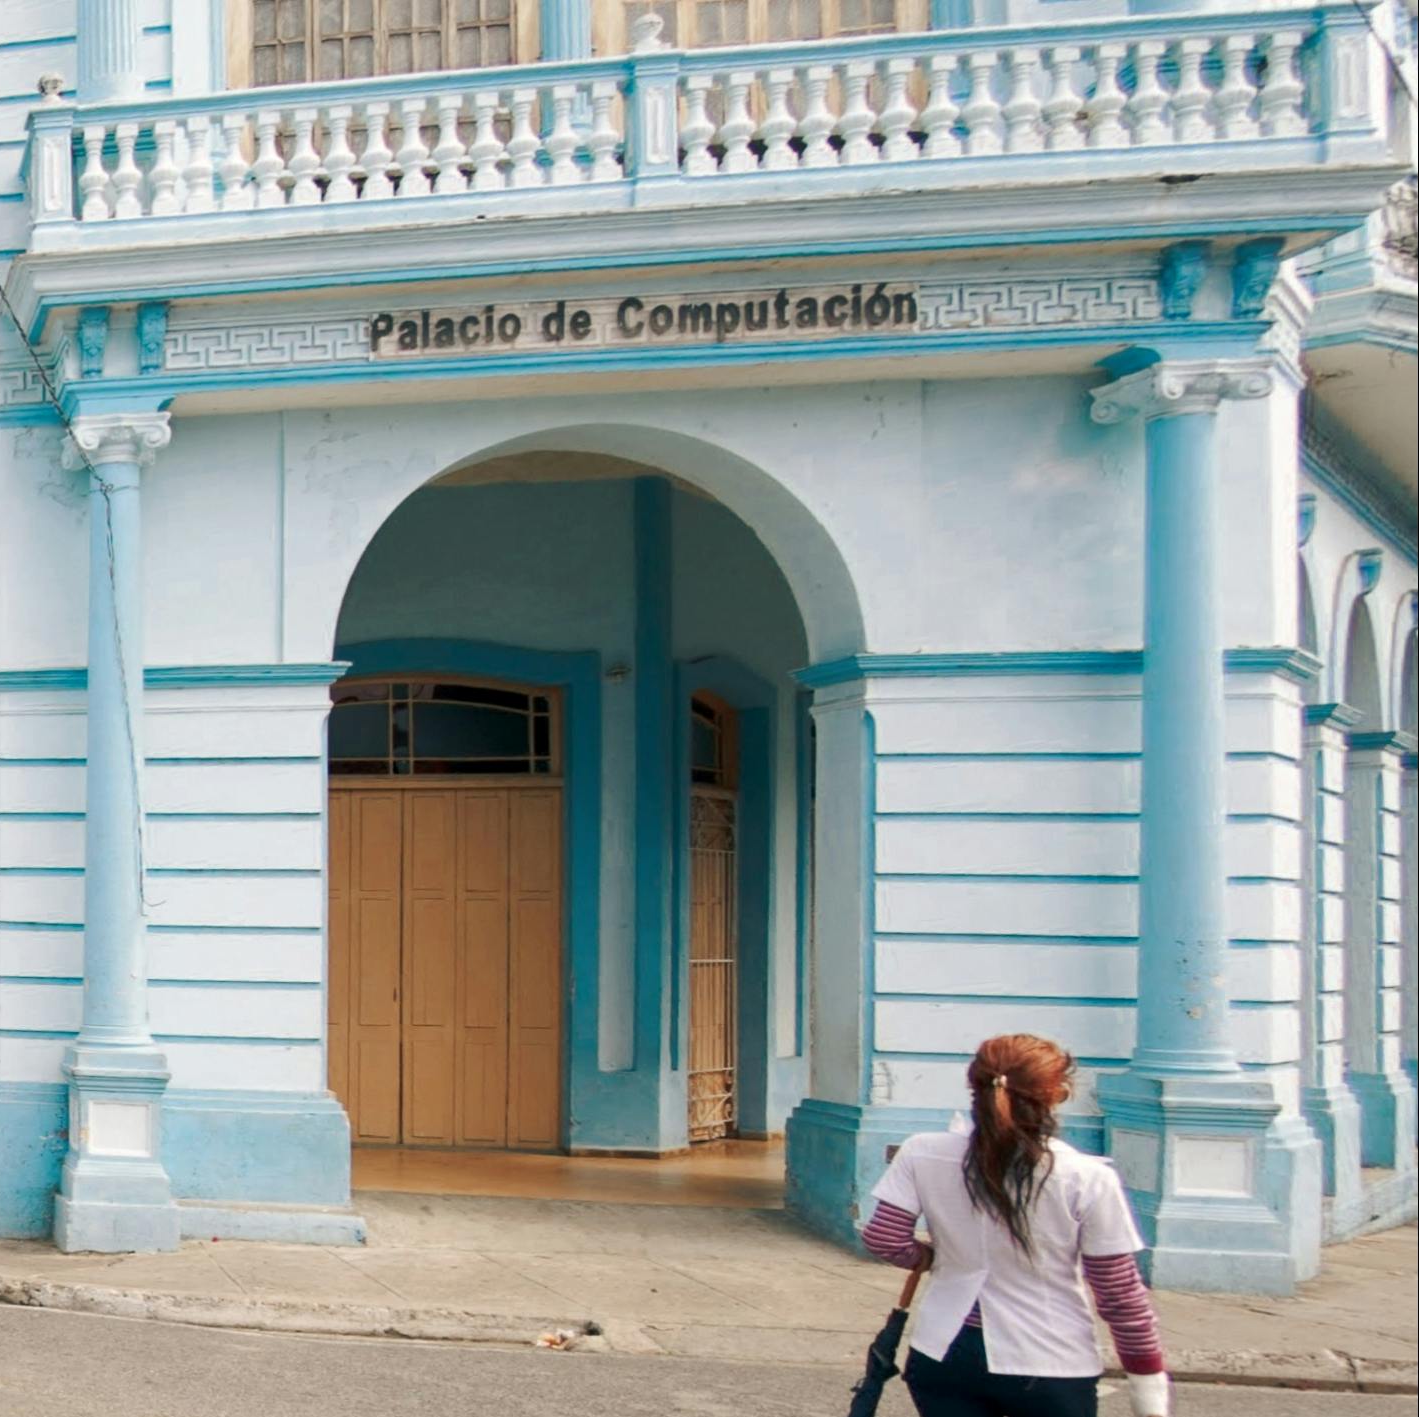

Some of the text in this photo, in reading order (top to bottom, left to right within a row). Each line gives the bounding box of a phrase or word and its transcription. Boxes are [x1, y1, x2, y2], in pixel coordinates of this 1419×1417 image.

[371, 281, 918, 352] Palacio de Computación
